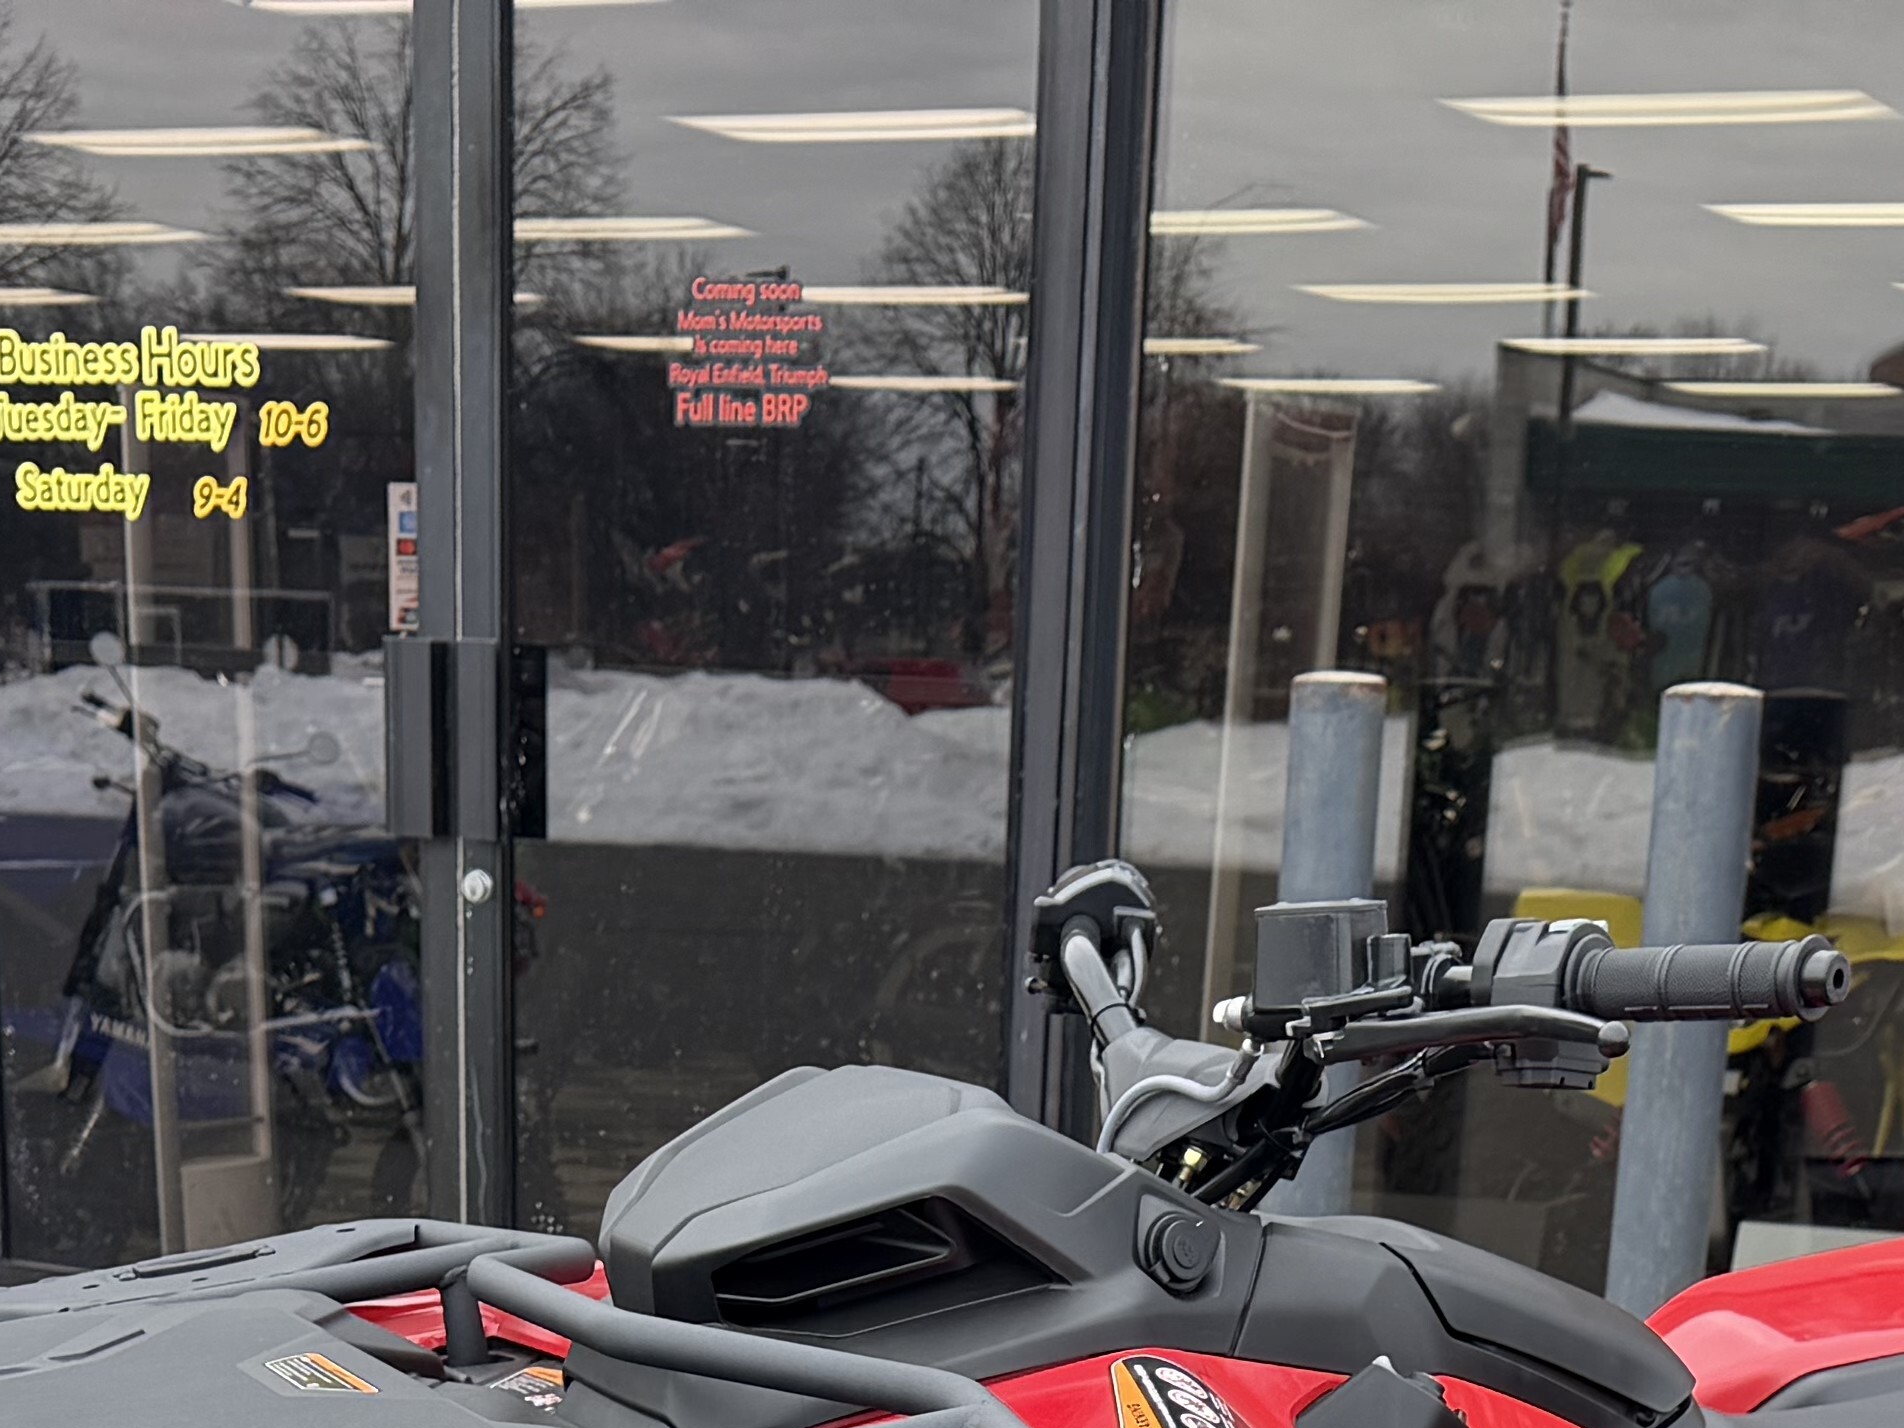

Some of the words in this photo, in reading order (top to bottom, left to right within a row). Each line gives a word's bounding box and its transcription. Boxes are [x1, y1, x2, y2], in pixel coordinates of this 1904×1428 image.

[692, 277, 757, 307] Coming
[760, 283, 802, 300] soon
[729, 310, 823, 334] Motorsports
[142, 326, 261, 387] Hours
[709, 336, 764, 359] coming
[765, 336, 799, 355] here
[669, 362, 711, 387] Royal
[768, 363, 829, 388] Triumph
[135, 390, 237, 453] Friday
[259, 401, 330, 447] 10-6
[677, 392, 714, 423] Full
[719, 394, 757, 422] line
[762, 393, 809, 424] BRP
[16, 461, 151, 521] Saturday
[194, 476, 248, 520] 9-4
[90, 1011, 150, 1050] YAMAH
